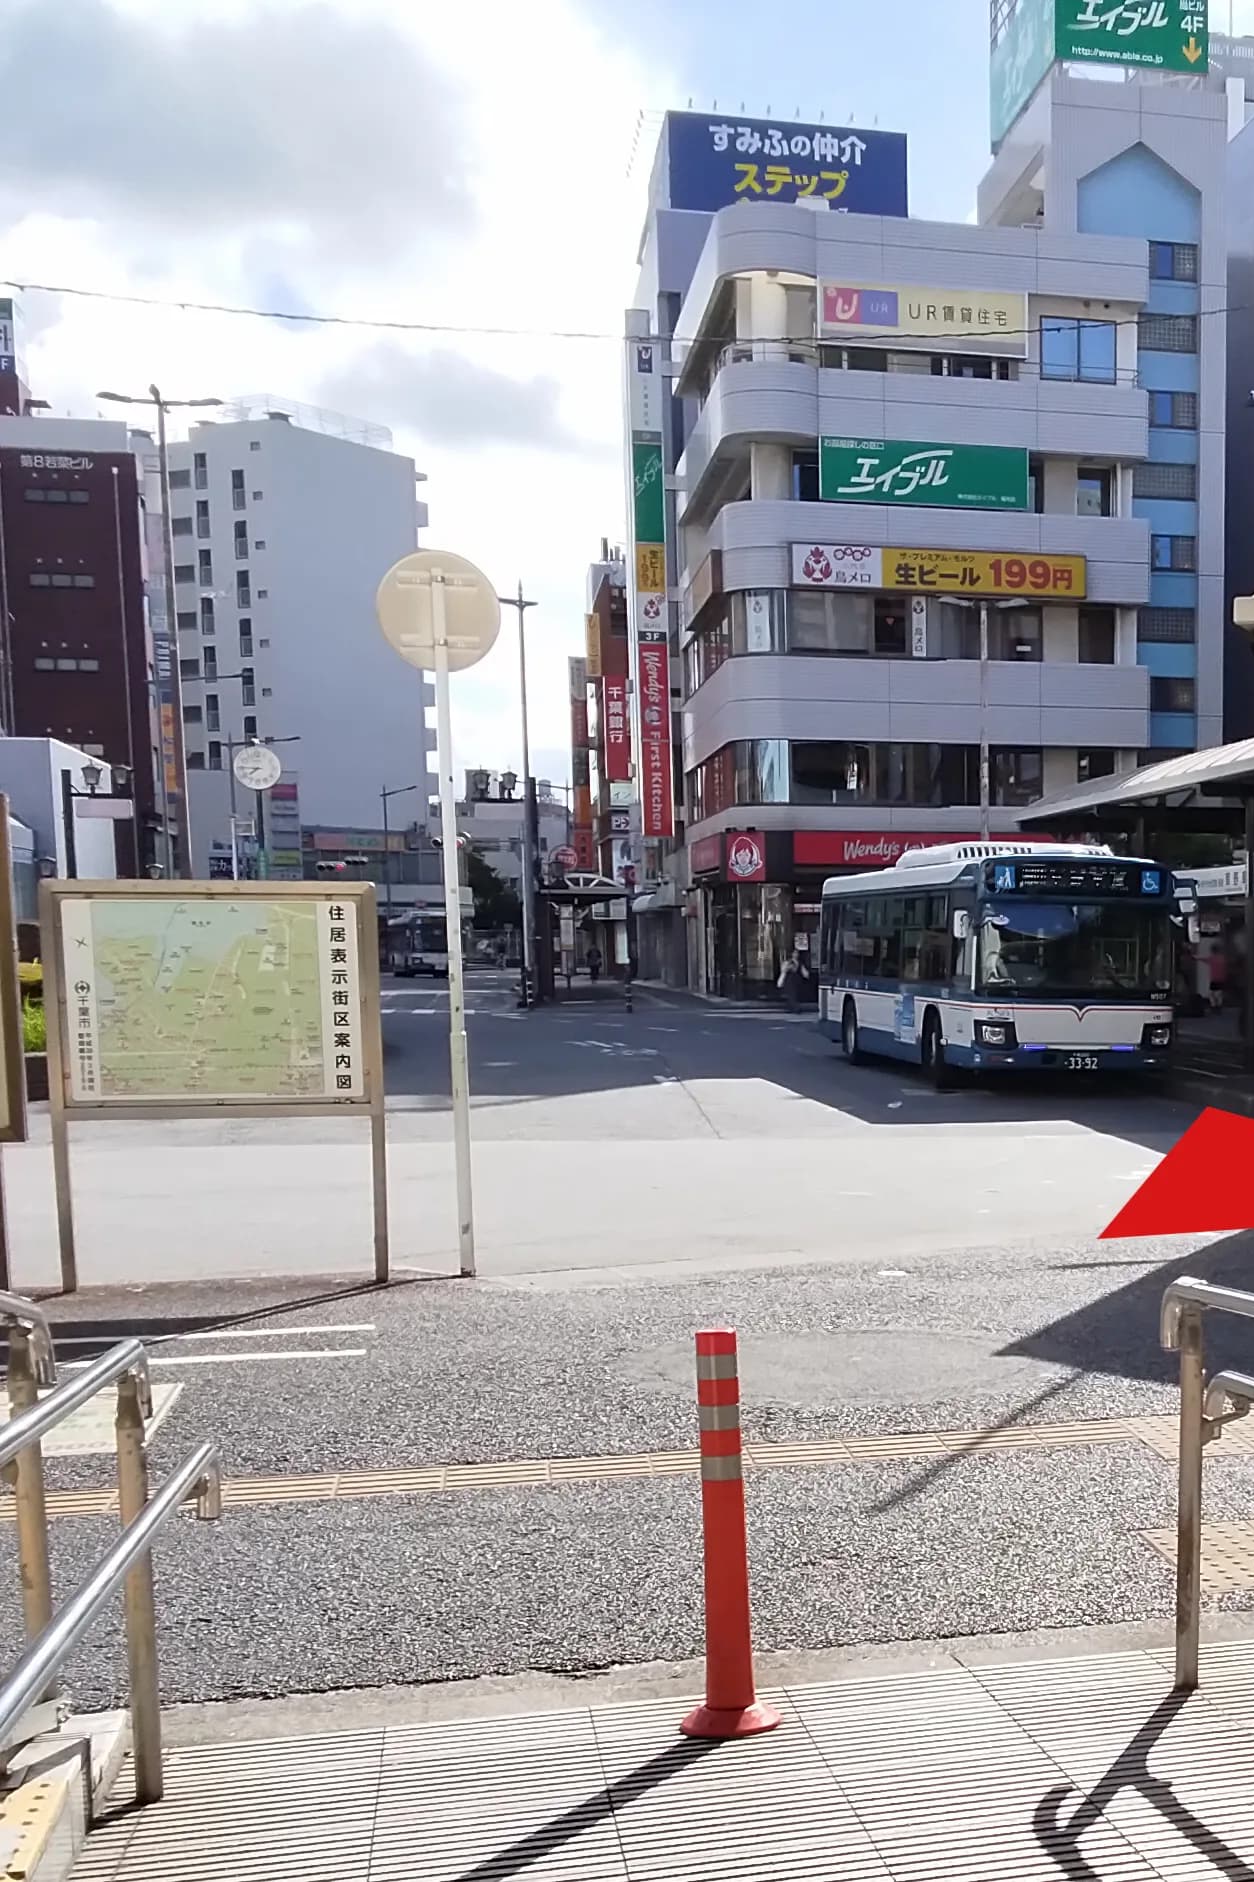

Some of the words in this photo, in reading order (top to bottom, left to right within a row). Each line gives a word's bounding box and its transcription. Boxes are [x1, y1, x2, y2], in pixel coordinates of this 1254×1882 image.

[1180, 15, 1204, 33] 4F
[1072, 45, 1163, 64] http://www.able.co.jp
[709, 124, 867, 165] すみふの仲介
[734, 162, 849, 199] ステップ
[908, 303, 1008, 326] UR賃貸住宅
[837, 450, 953, 496] エイブル
[834, 571, 871, 584] 鳥メロ
[895, 563, 981, 587] 生ビール
[989, 558, 1073, 590] 199円
[645, 633, 660, 641] 3F
[642, 651, 663, 705] Wendy's
[607, 687, 624, 743] 千葉銀行
[650, 731, 661, 770] First
[650, 772, 663, 830] Kitchen
[844, 838, 900, 861] Wendy's
[78, 996, 92, 1029] 千葉市
[329, 906, 352, 1090] 住居表示街区案内図
[1067, 1057, 1098, 1070] 33-92
